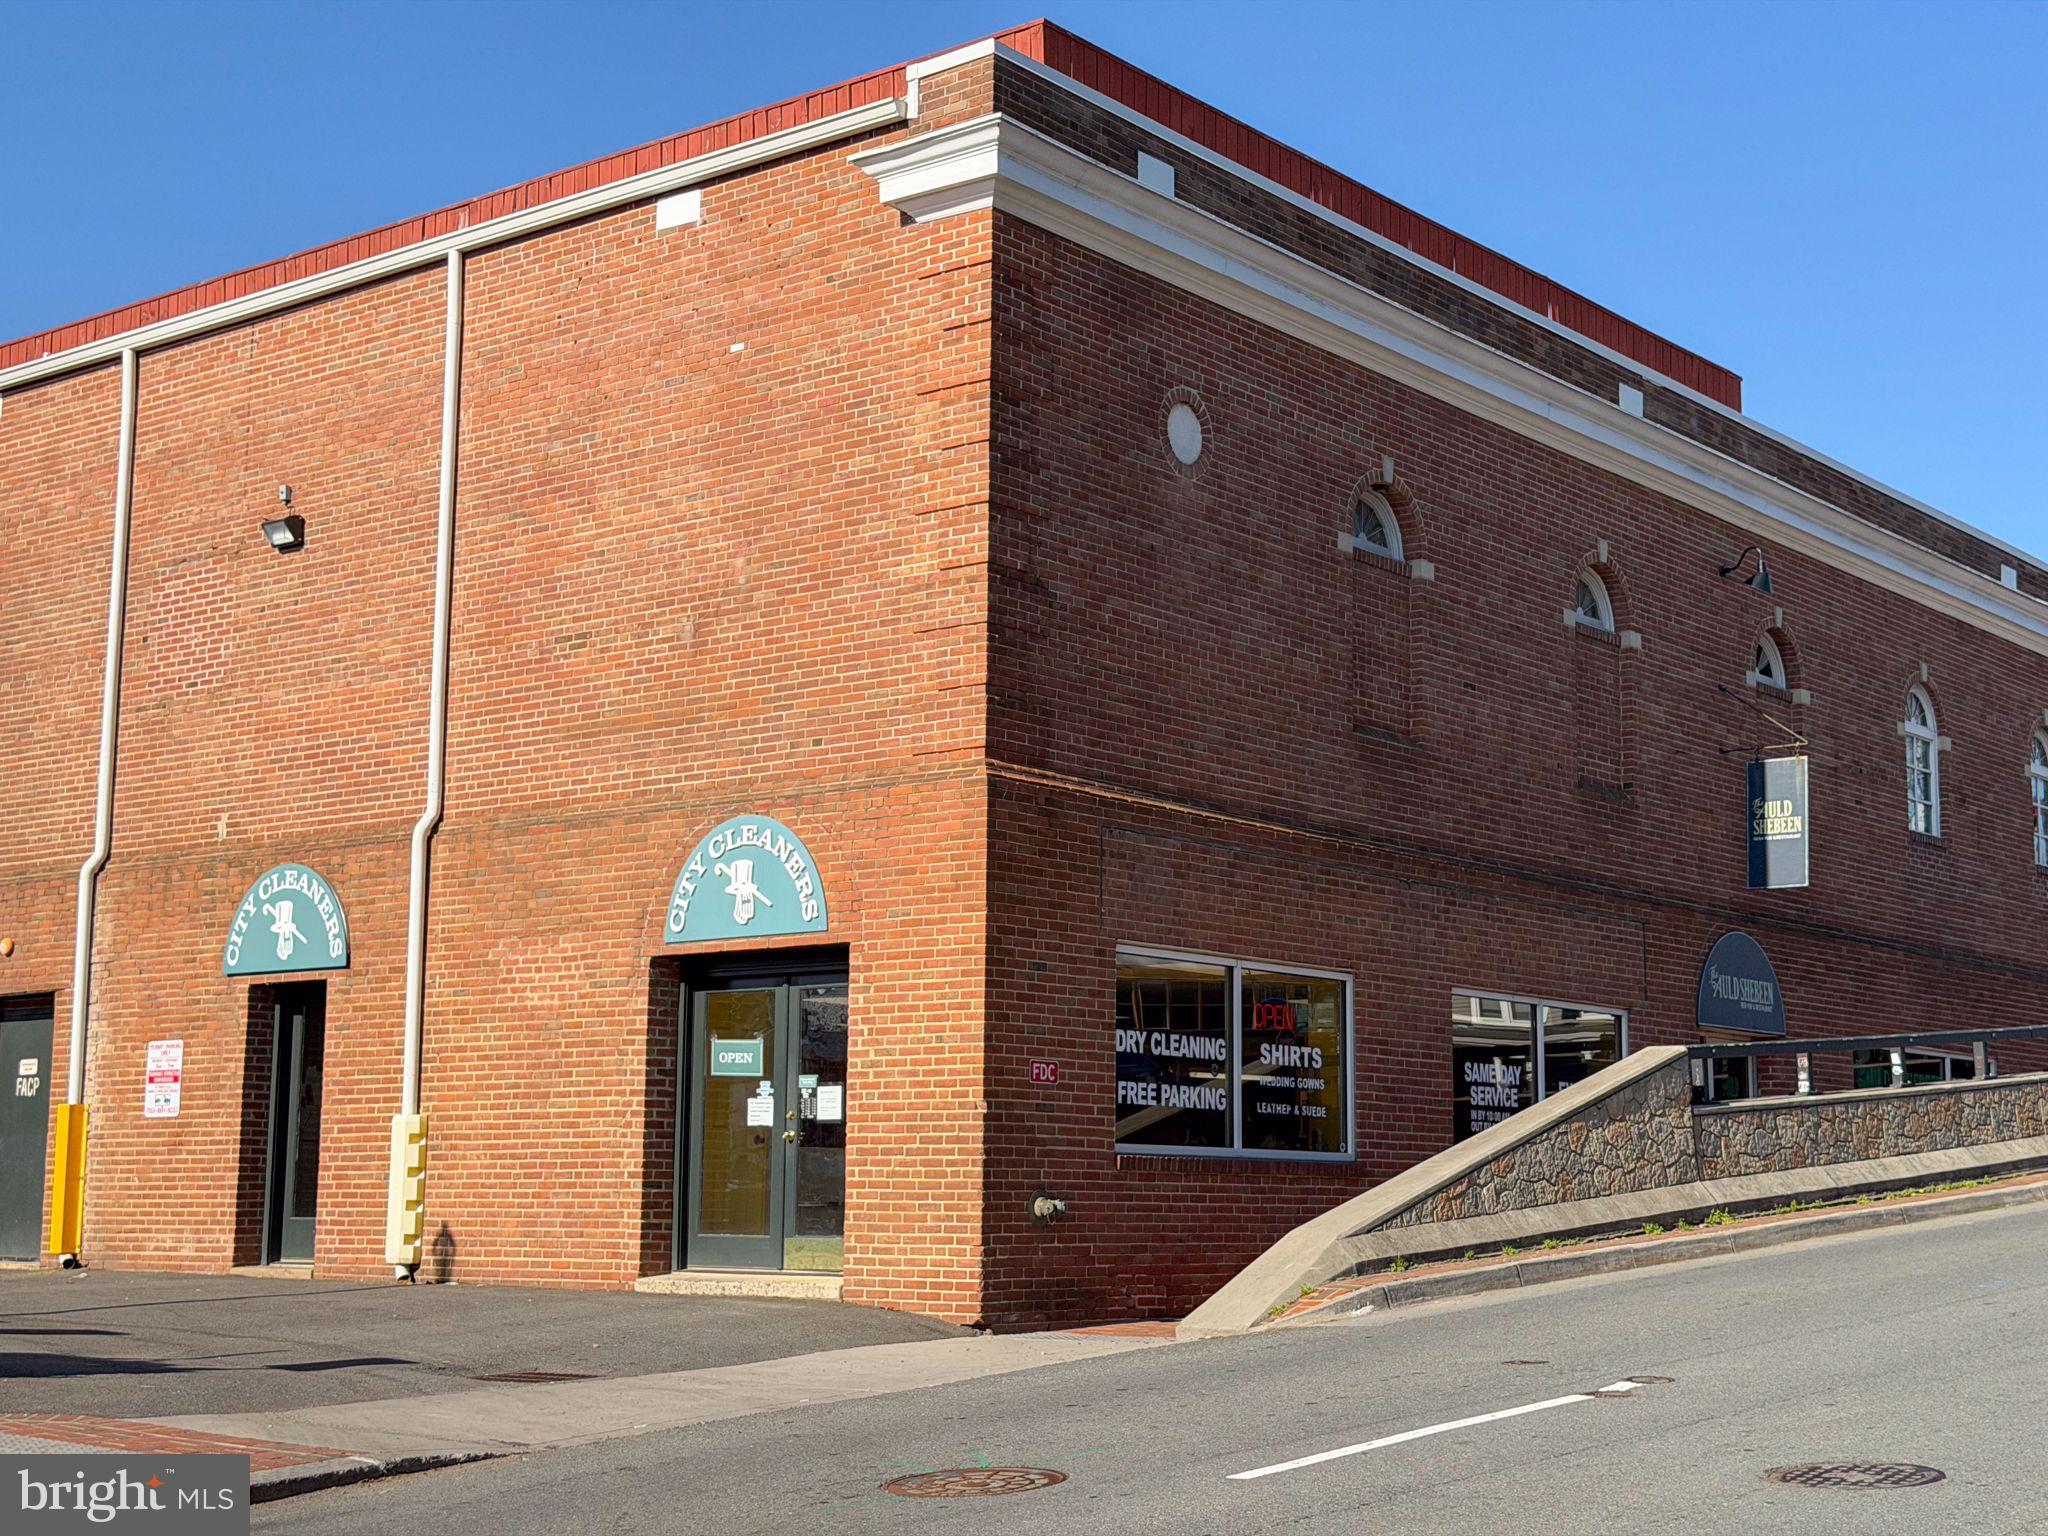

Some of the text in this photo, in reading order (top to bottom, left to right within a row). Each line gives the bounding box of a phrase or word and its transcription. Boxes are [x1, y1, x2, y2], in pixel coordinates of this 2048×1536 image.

[1754, 799, 1793, 819] AULD
[1753, 815, 1802, 835] SHEBEEN
[669, 825, 819, 933] CITY CLEANERS
[226, 870, 343, 967] CITY CLEANERS
[1712, 974, 1774, 1005] AULD SHEBEEN
[1253, 1003, 1295, 1031] OPEN
[1115, 1029, 1227, 1061] DRY CLEANING
[1259, 1042, 1323, 1069] SHIRTS
[719, 1052, 754, 1064] OPEN
[1032, 1062, 1056, 1081] FDC
[1464, 1061, 1496, 1084] SAME
[1500, 1064, 1522, 1086] DAY
[15, 1077, 40, 1097] FACP
[1259, 1075, 1325, 1090] WEDDING GOWNS
[1117, 1081, 1227, 1111] FREE PARKING
[1470, 1085, 1519, 1108] SERVICE
[1301, 1106, 1327, 1118] SUEDE
[1470, 1109, 1477, 1120] IN
[1478, 1110, 1486, 1121] BY
[1471, 1121, 1483, 1132] OUT
